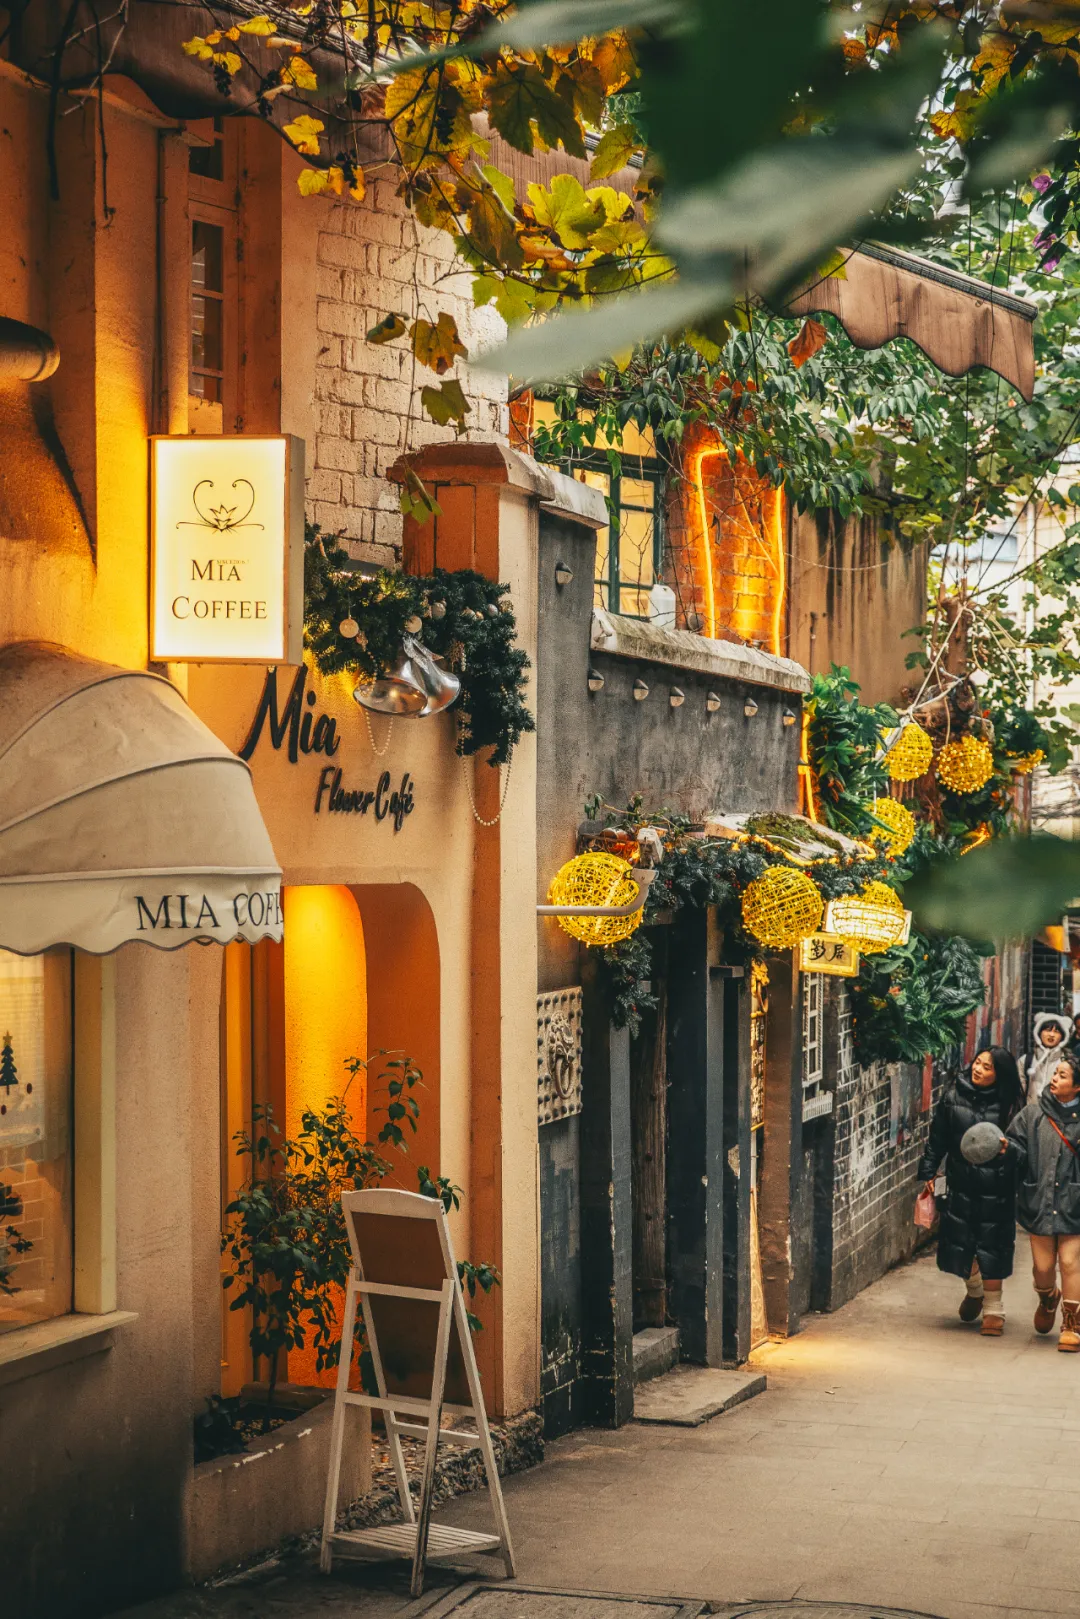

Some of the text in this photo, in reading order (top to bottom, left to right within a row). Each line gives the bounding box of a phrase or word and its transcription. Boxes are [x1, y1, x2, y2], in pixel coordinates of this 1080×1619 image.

[190, 559, 242, 581] MIA
[171, 596, 268, 619] COFFEE
[238, 663, 341, 764] Mia
[314, 766, 376, 814] Flower
[134, 892, 284, 930] MIA COFF
